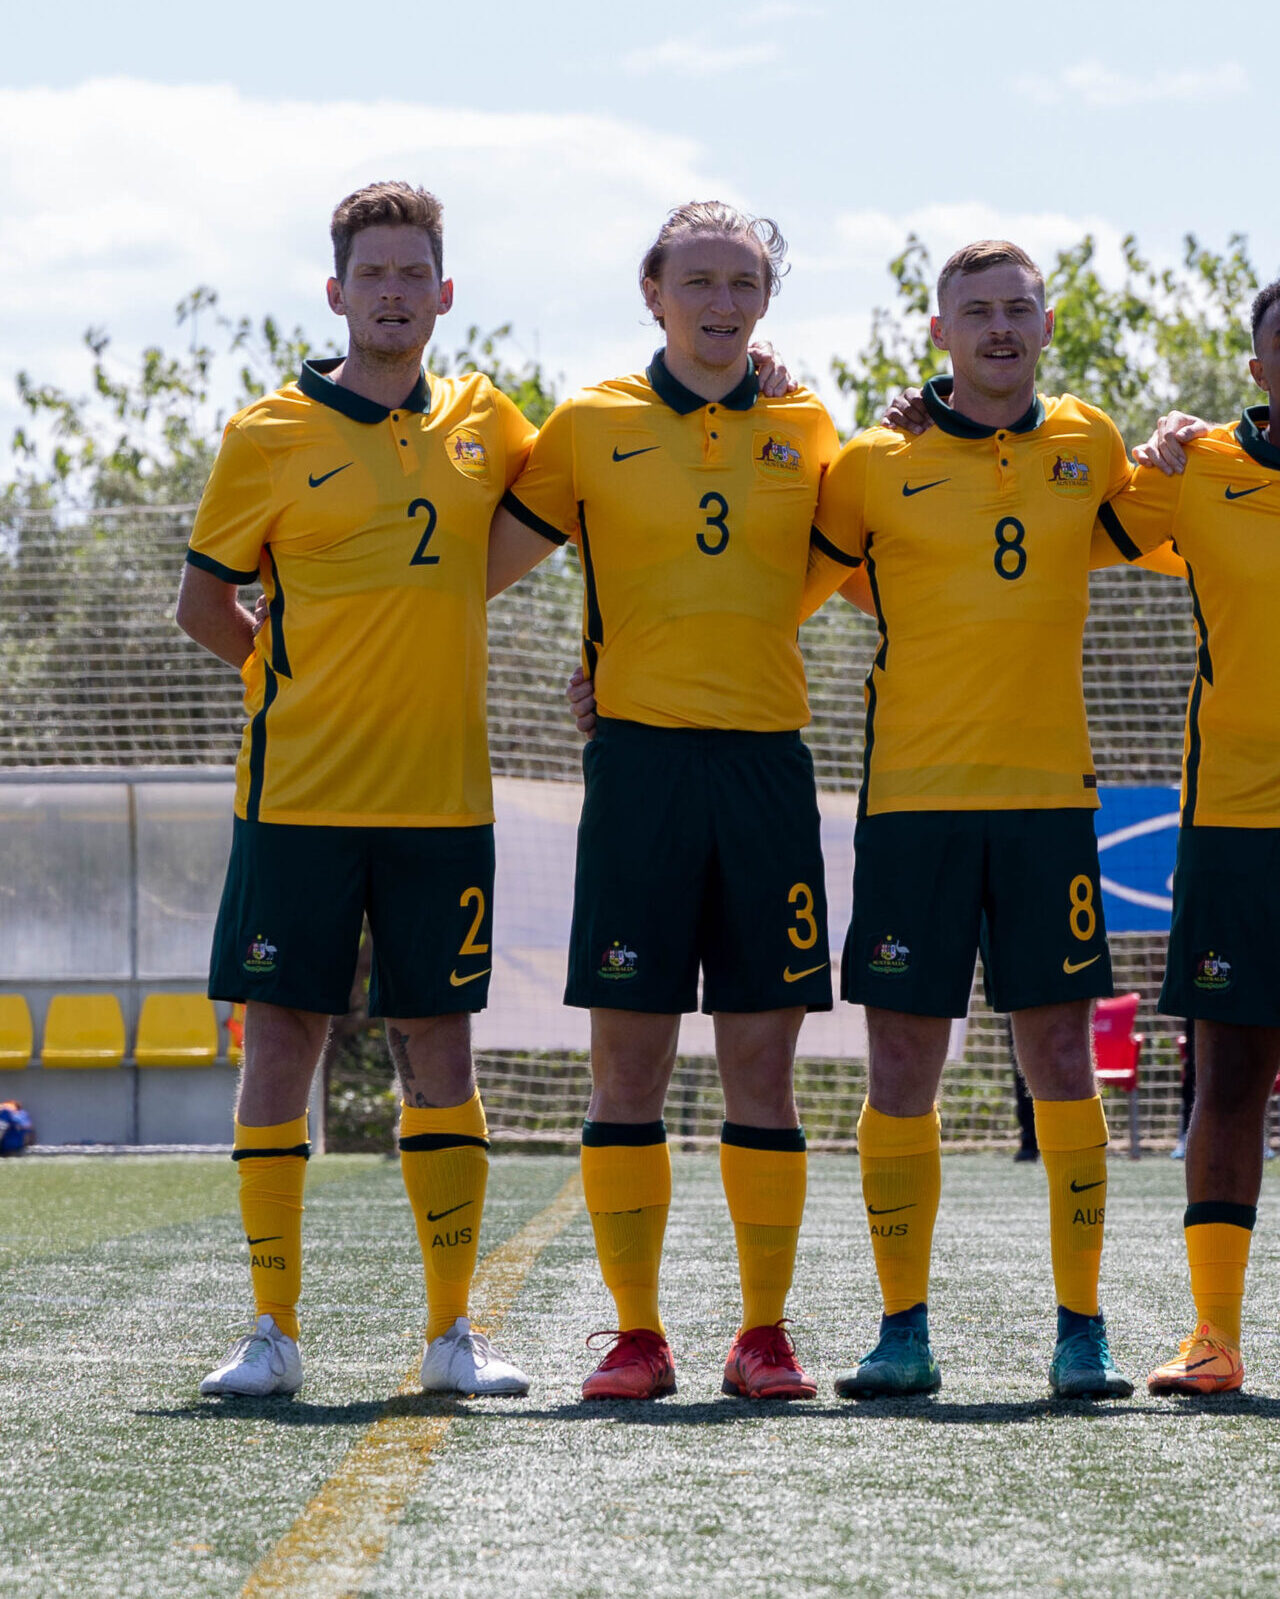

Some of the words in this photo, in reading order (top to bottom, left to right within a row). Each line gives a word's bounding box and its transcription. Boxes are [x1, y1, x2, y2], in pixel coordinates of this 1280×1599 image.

[406, 498, 441, 566] 2
[695, 490, 730, 556] 3
[994, 517, 1027, 580] 8
[458, 886, 488, 955] 2
[788, 882, 818, 950] 3
[1069, 874, 1096, 941] 8
[431, 1227, 473, 1248] AUS
[871, 1222, 909, 1237] AUS
[1072, 1207, 1105, 1225] AUS
[251, 1254, 286, 1270] AUS
